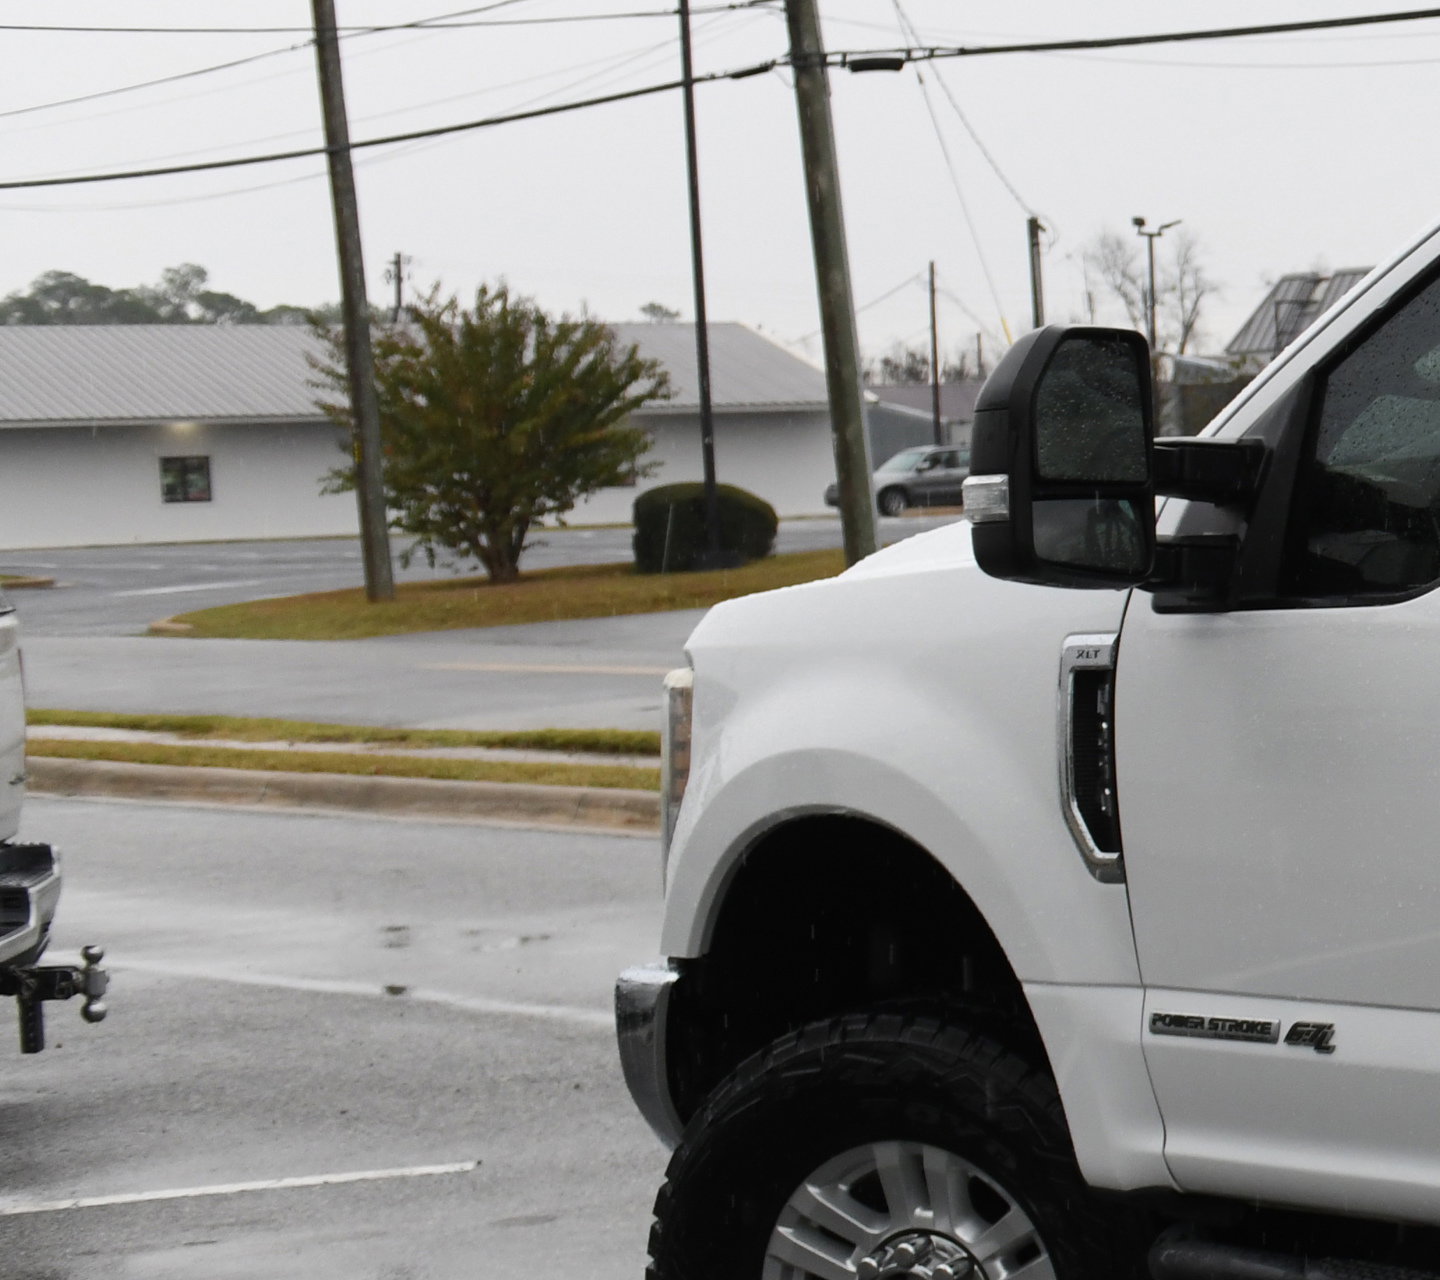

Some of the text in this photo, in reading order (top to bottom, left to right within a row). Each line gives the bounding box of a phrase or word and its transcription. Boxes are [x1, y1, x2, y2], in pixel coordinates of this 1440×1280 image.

[1075, 649, 1101, 660] XLT
[1151, 1013, 1205, 1030] POWER
[1208, 1017, 1272, 1035] STROKE
